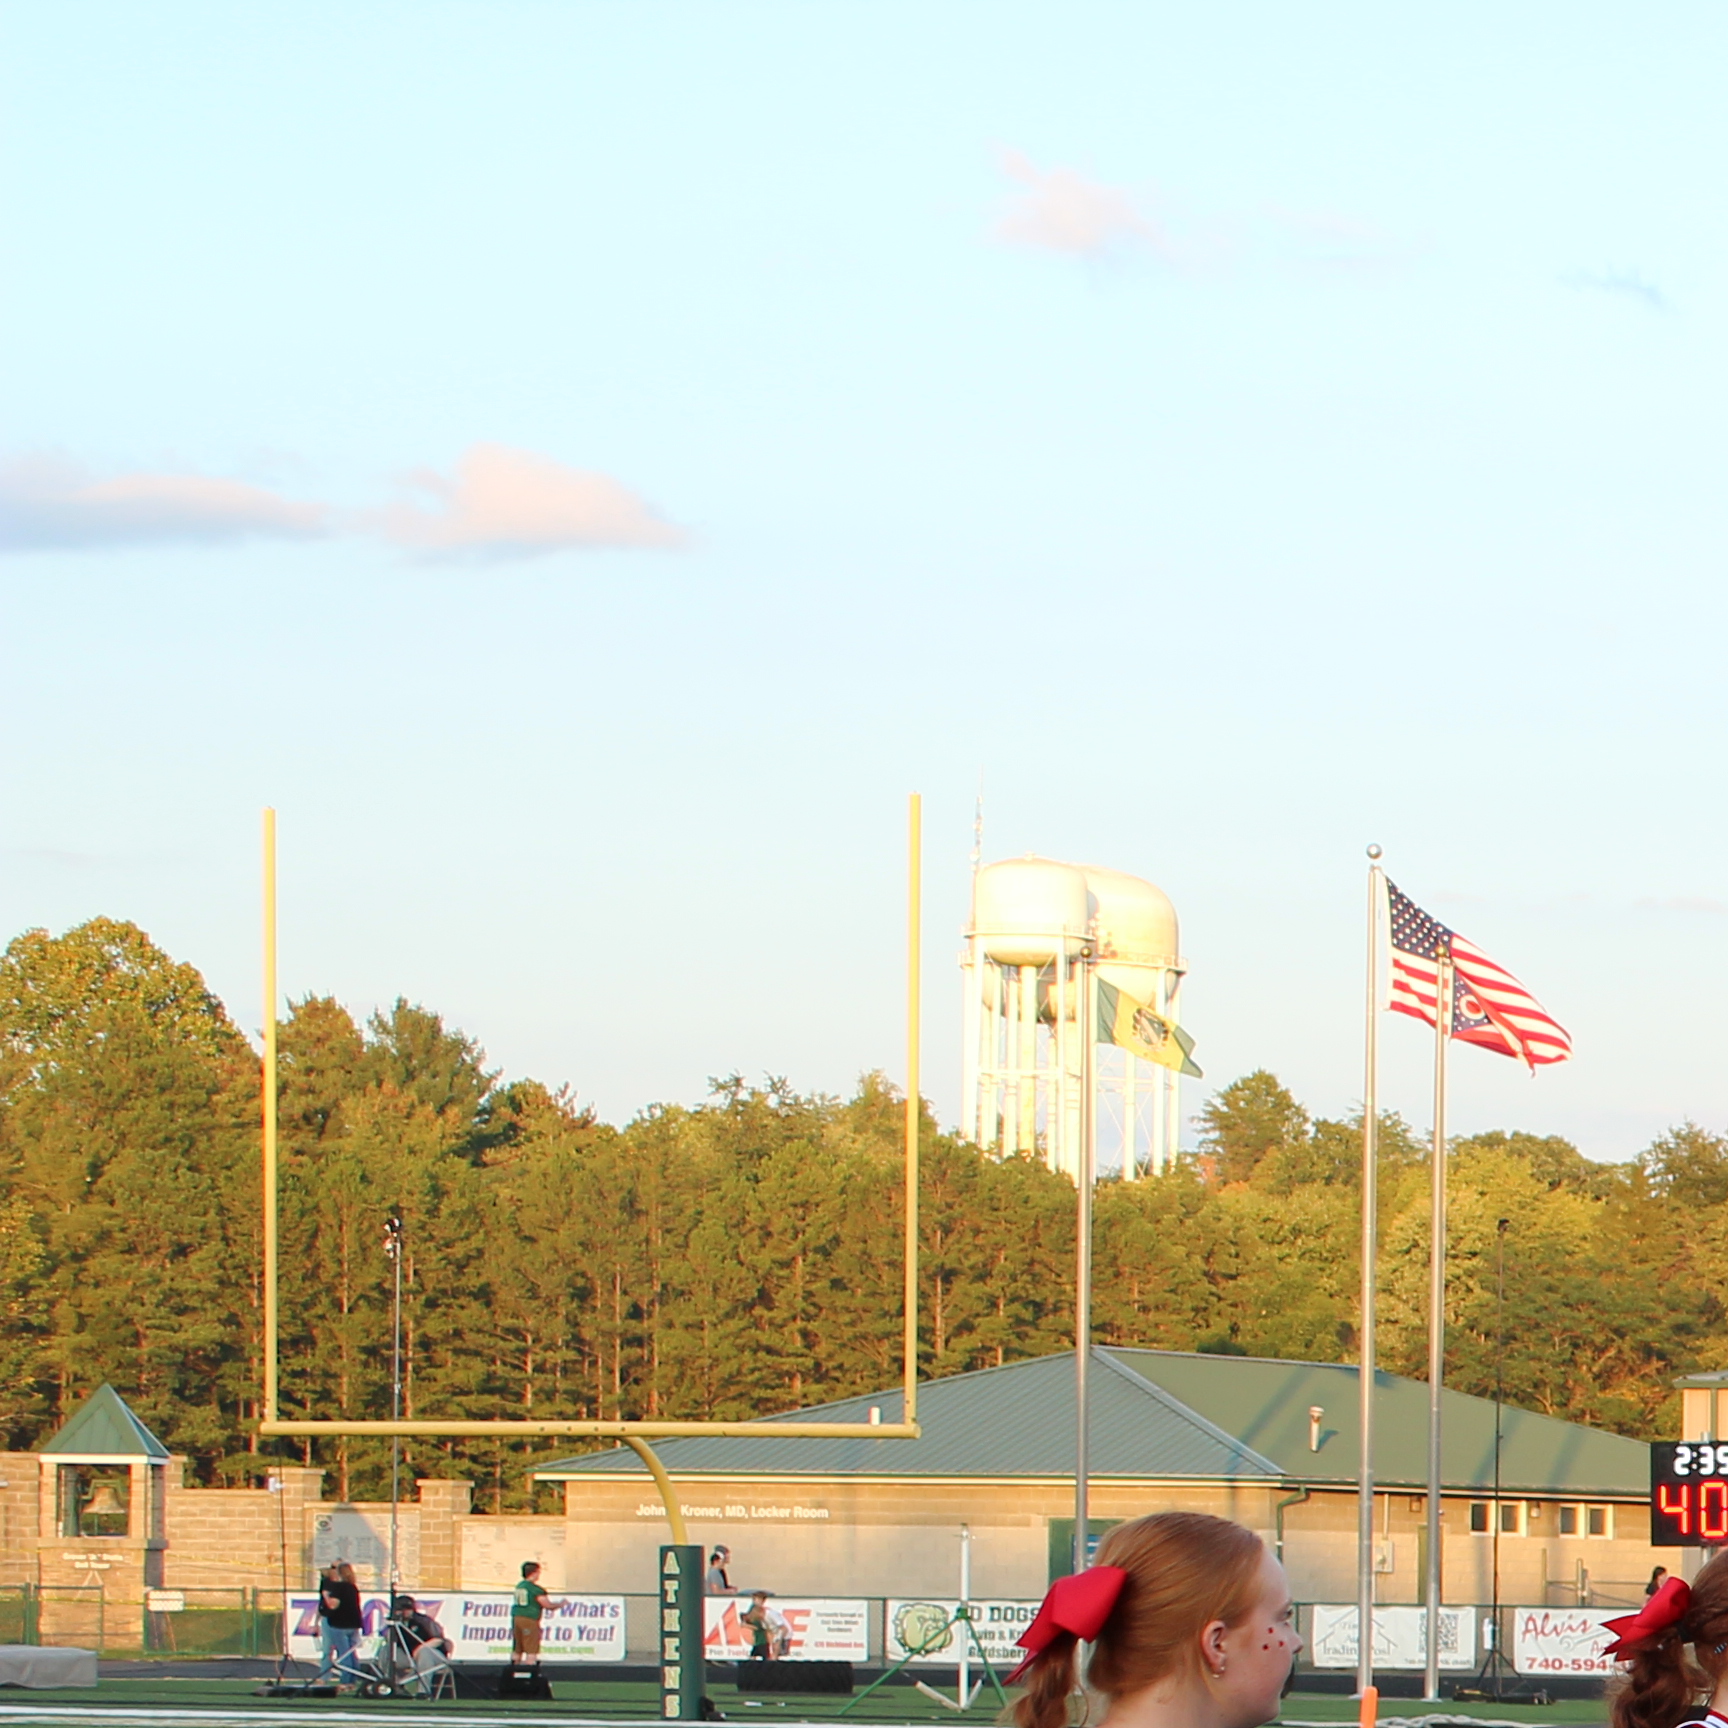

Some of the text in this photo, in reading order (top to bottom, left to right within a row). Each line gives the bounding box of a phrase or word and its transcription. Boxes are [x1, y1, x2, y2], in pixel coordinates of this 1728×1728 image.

[636, 1504, 829, 1519] John Kroner, MD, Locker Room
[560, 1602, 620, 1618] What's
[555, 1626, 573, 1641] to
[577, 1625, 616, 1641] You!
[663, 1551, 681, 1718] ATHENS
[1522, 1612, 1592, 1642] Alvis
